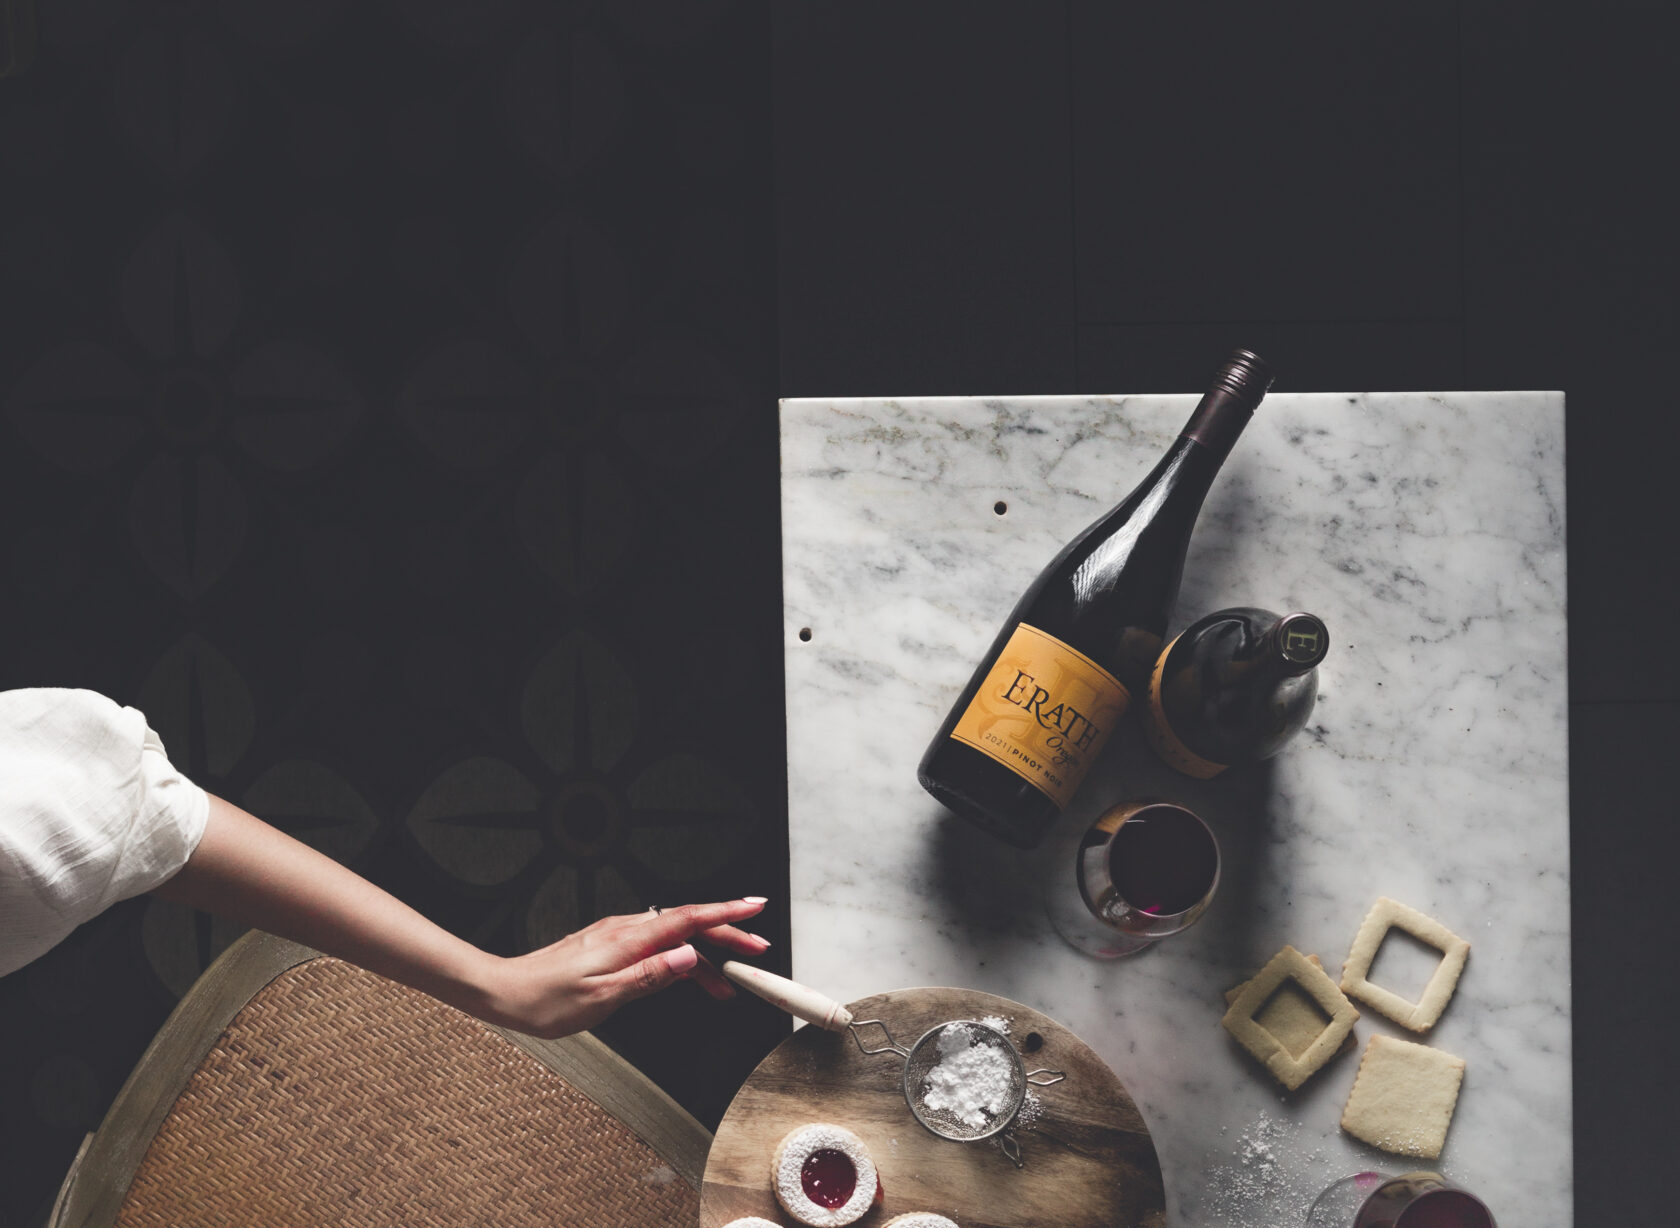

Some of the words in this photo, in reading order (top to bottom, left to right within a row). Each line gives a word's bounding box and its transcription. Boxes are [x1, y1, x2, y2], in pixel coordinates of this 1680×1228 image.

[1286, 628, 1319, 652] E
[1002, 669, 1100, 752] ERATH
[985, 733, 1007, 749] 2021
[1012, 749, 1043, 771] PINOT
